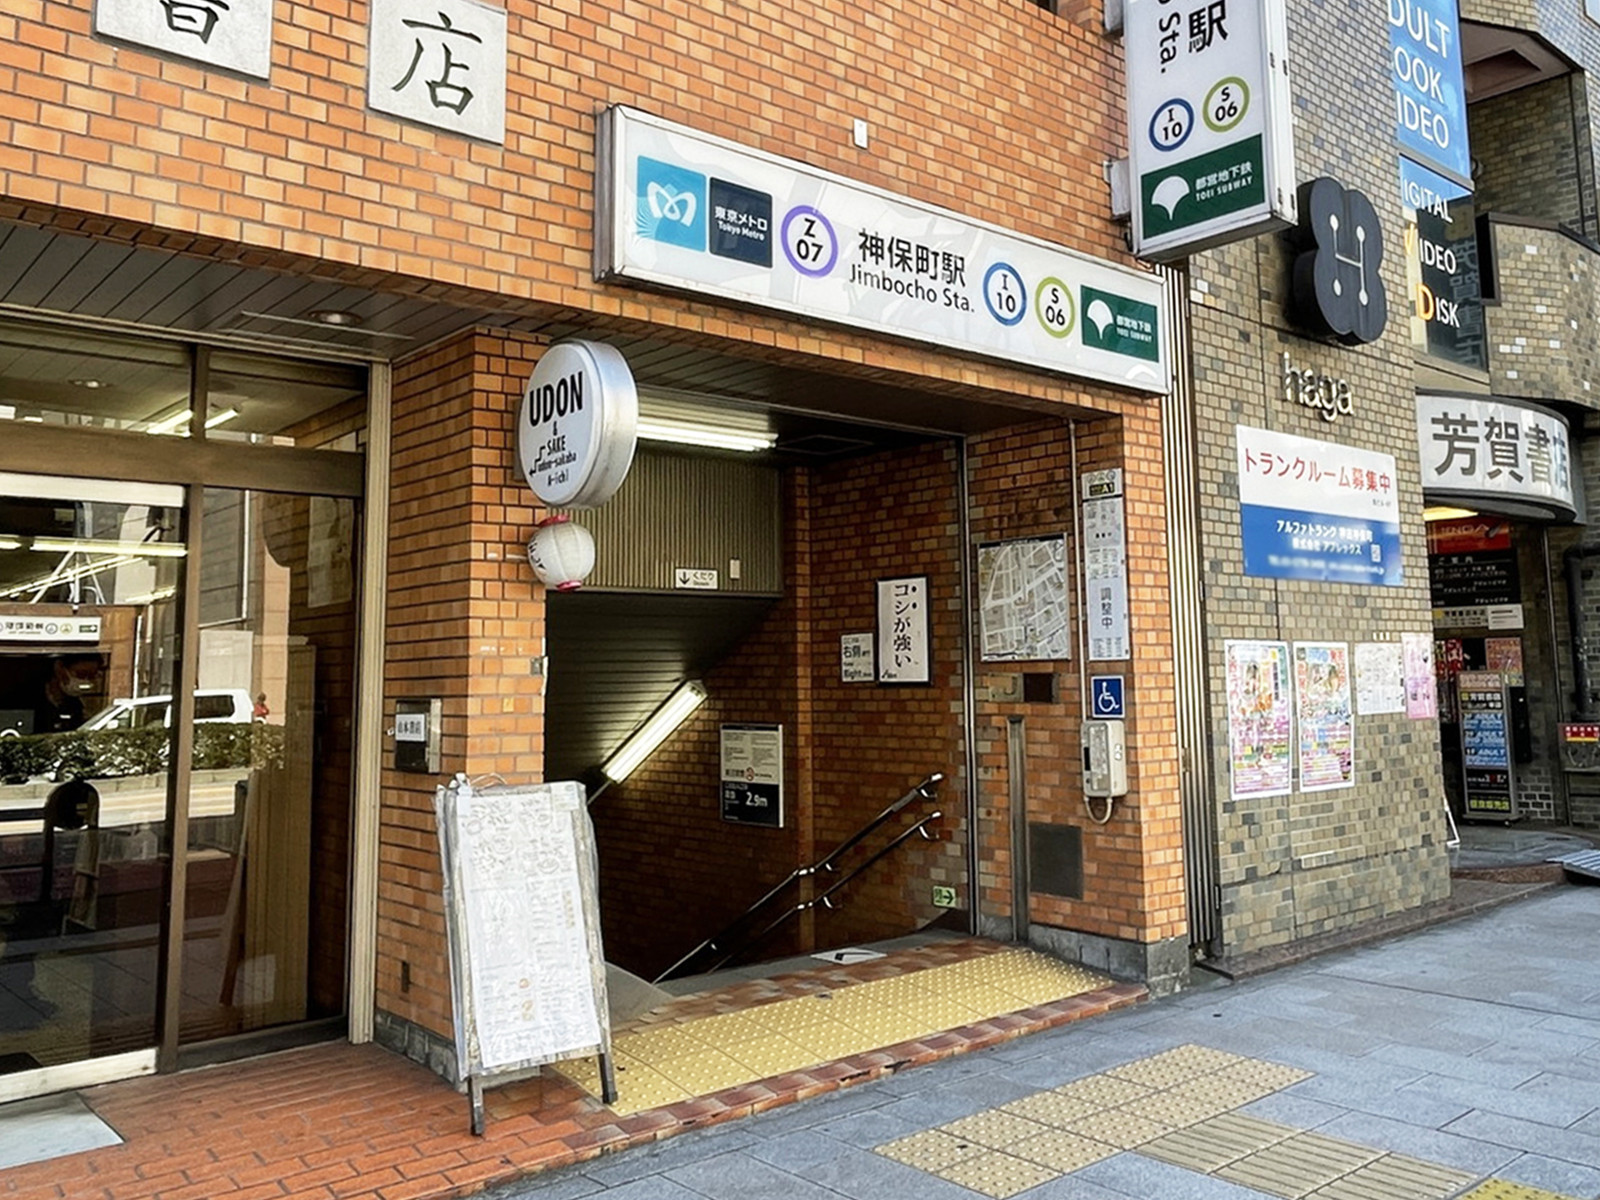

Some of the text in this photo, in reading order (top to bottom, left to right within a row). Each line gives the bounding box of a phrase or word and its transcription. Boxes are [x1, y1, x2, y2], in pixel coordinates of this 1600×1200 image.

[1158, 11, 1181, 74] Sta.
[1221, 87, 1231, 102] S
[1168, 108, 1174, 123] I
[1215, 103, 1238, 122] 06
[1163, 122, 1183, 141] 10
[1196, 176, 1252, 201] TOEI SUBWAY
[715, 206, 767, 231] 東京メトロ
[803, 218, 816, 238] Z
[718, 221, 765, 241] Tokyo Metro
[796, 239, 823, 262] 07
[858, 229, 966, 288] 神保町駅
[849, 263, 975, 313] Jimbocho Sta.
[1001, 274, 1009, 291] I
[996, 291, 1016, 313] 10
[1050, 287, 1060, 305] S
[1045, 305, 1065, 327] 06
[1282, 351, 1354, 421] haga
[529, 371, 583, 427] UDON
[547, 435, 567, 456] SAKE
[1431, 411, 1569, 492] 芳賀書店
[1245, 448, 1391, 494] トランクルーム募集中
[1277, 520, 1337, 538] アルファトランク
[894, 584, 914, 668] コシが強い
